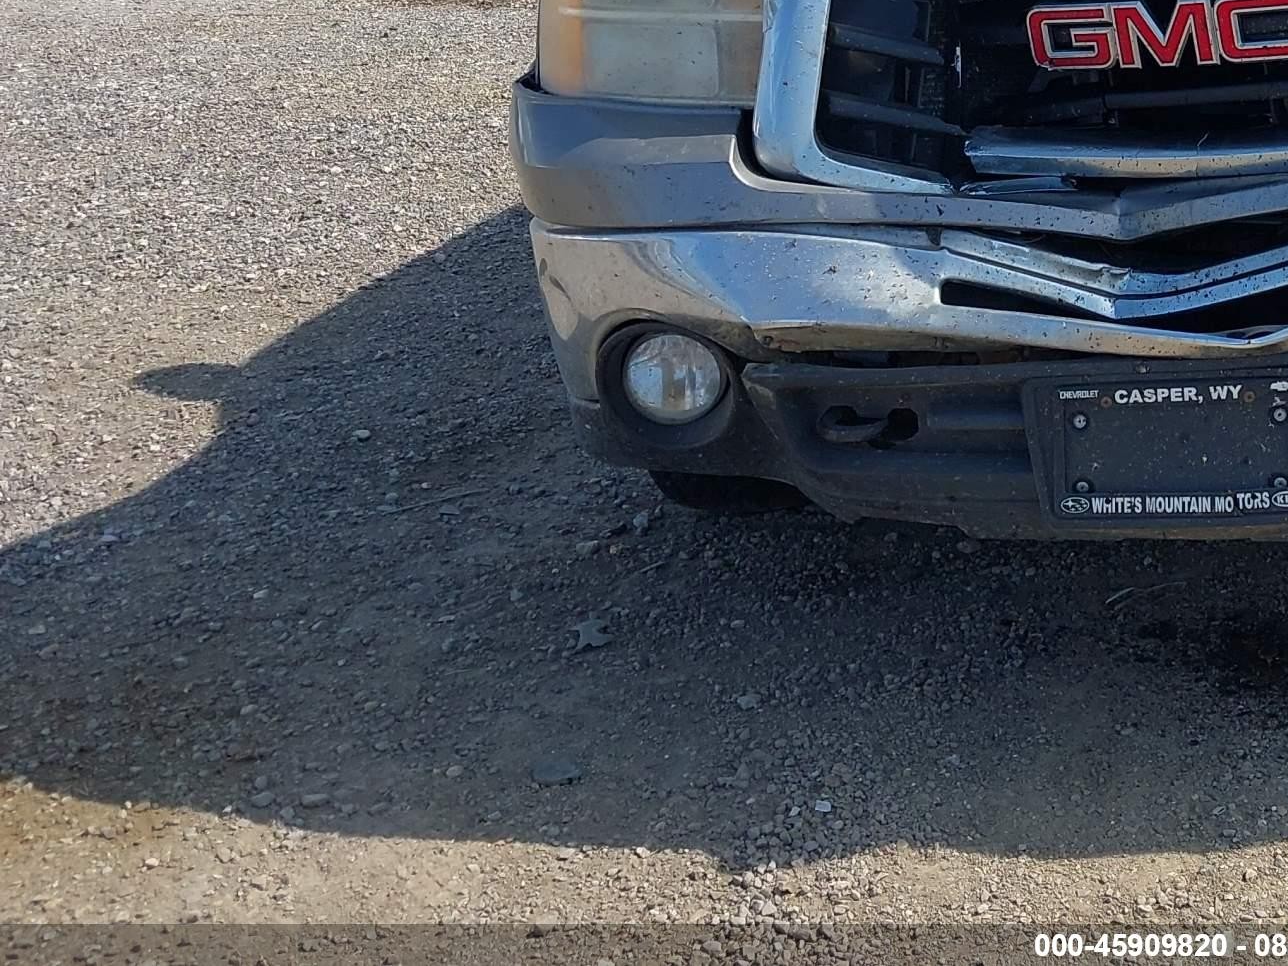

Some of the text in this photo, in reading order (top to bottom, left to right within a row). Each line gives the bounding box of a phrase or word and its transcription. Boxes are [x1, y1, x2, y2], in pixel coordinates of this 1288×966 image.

[1059, 390, 1099, 400] CHEVROLET
[1114, 384, 1242, 404] CASPER, WY
[1091, 496, 1142, 514] WHITE'S
[1146, 495, 1211, 514] MOUNTAIN
